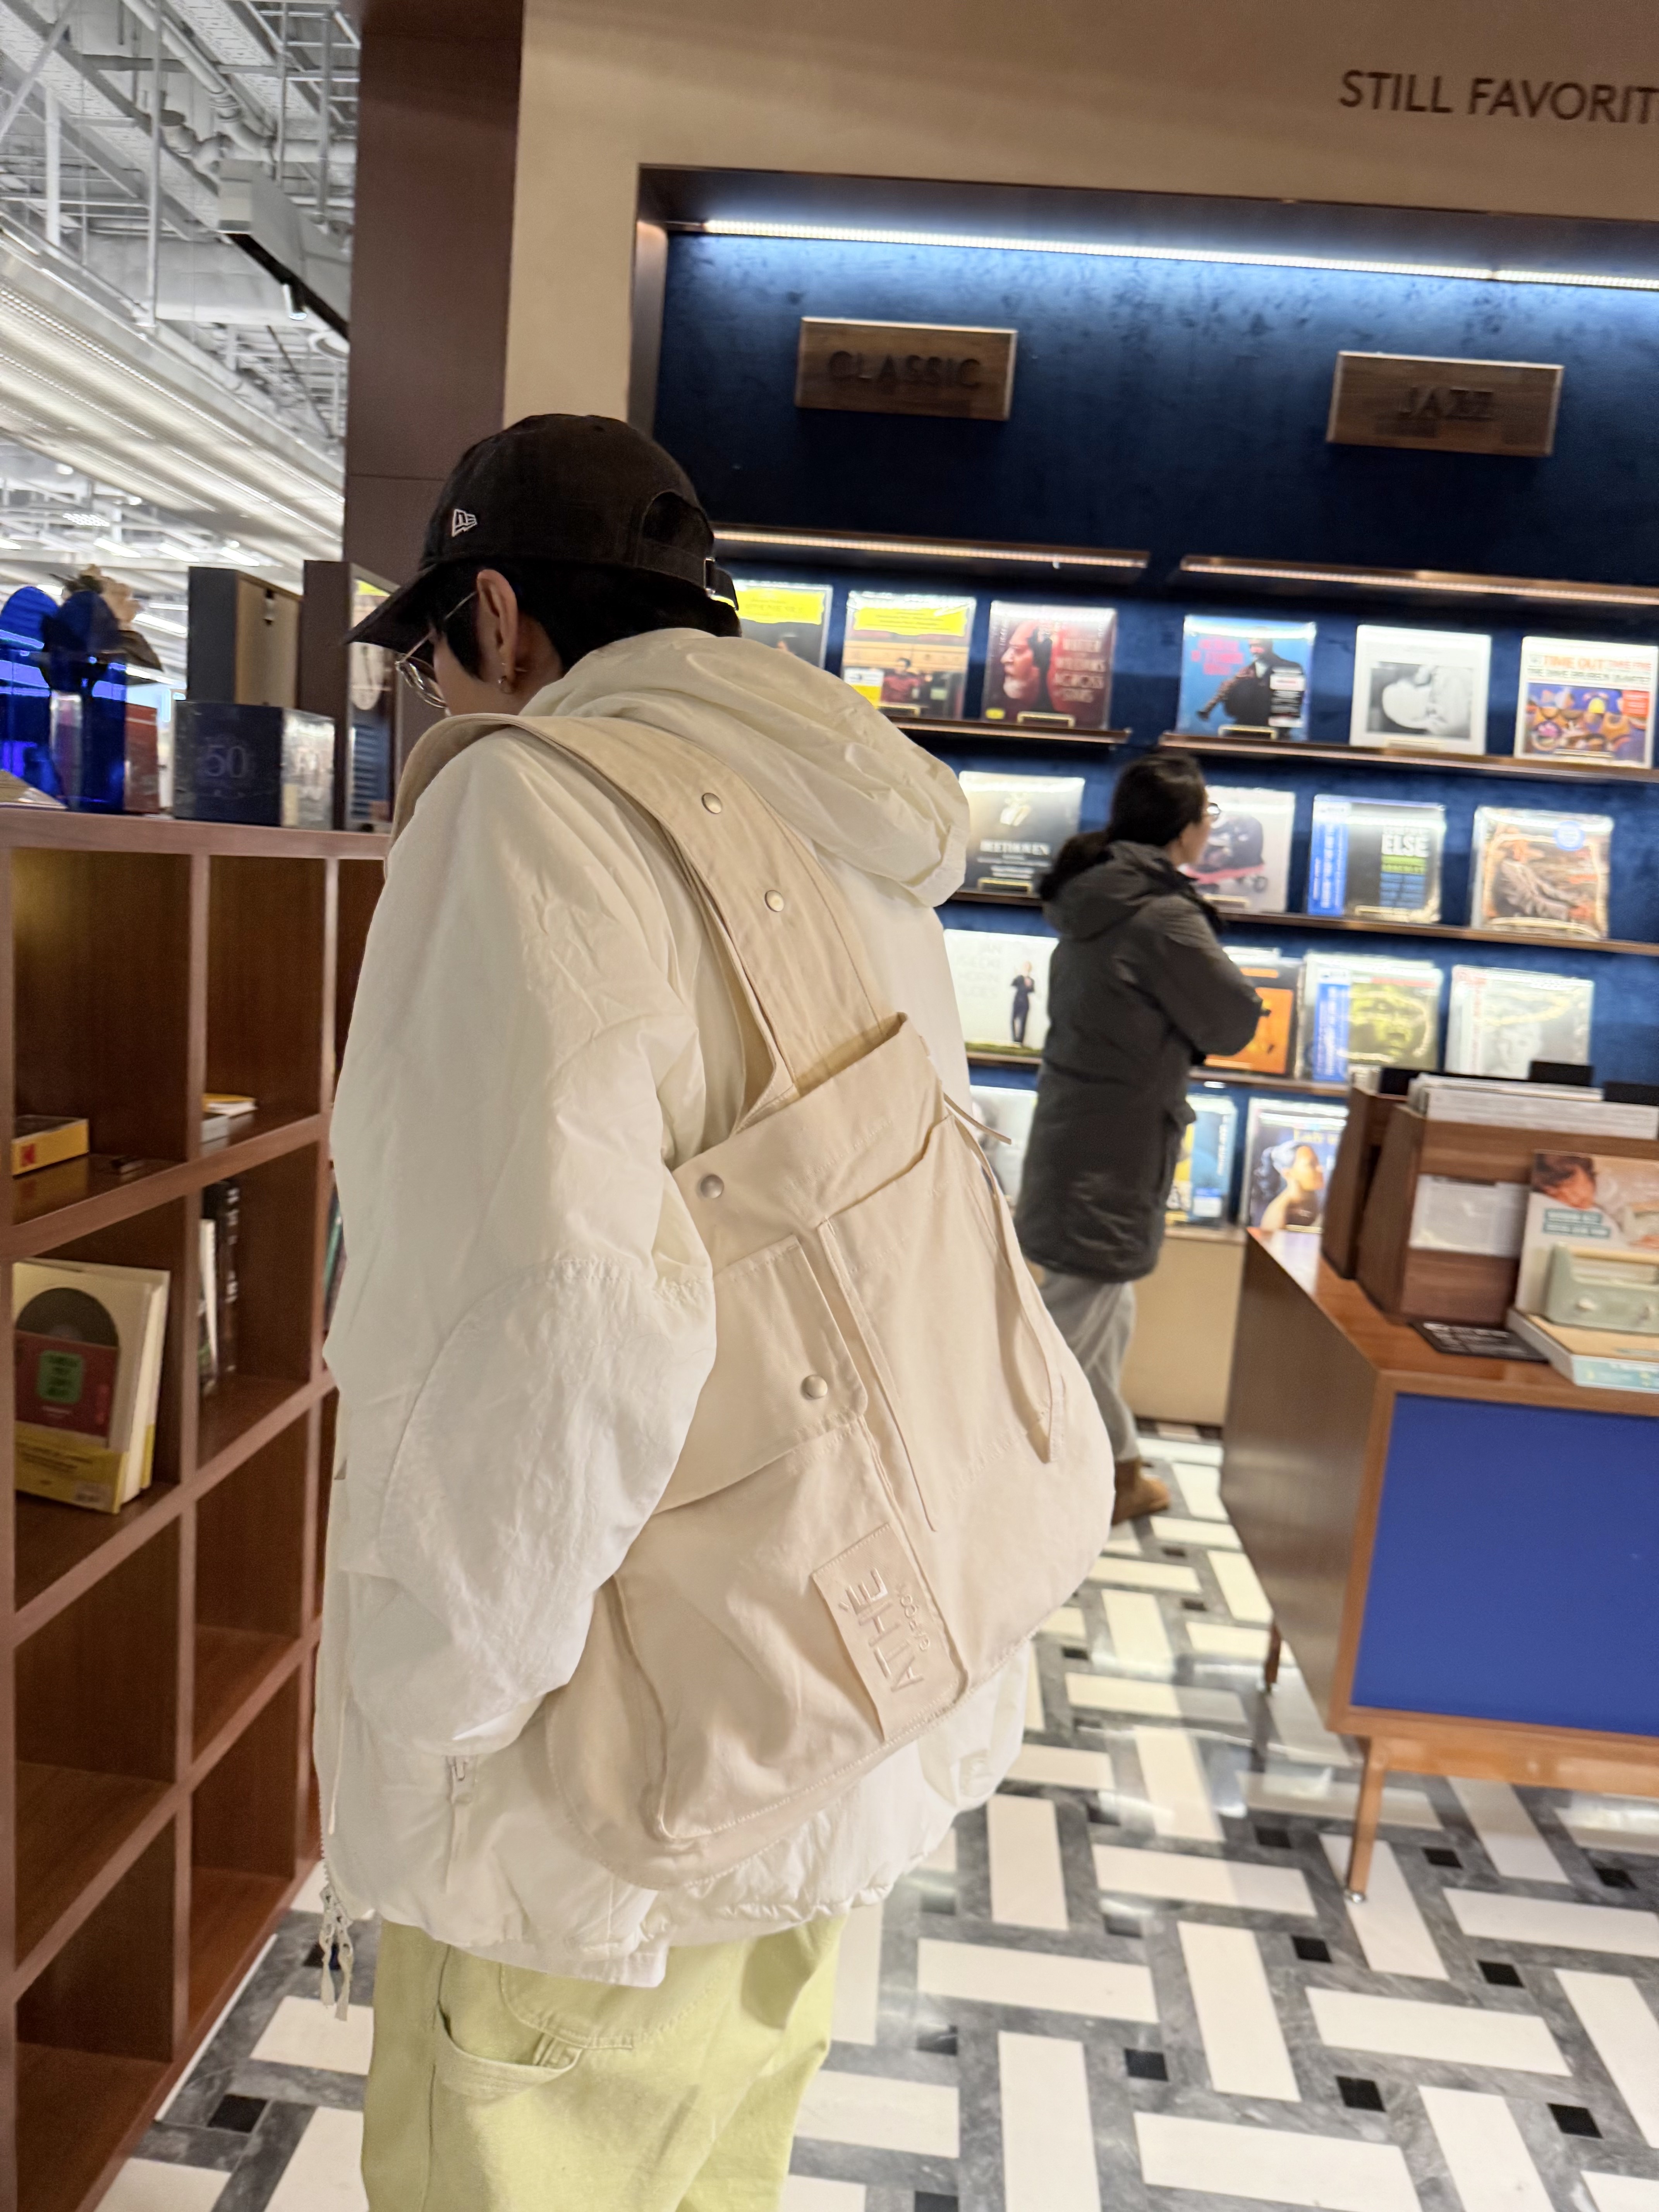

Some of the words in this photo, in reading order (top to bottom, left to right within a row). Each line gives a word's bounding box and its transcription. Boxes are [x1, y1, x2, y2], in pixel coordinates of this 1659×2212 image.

[1339, 70, 1453, 113] STILL
[1468, 77, 1659, 124] FAVORIT
[1381, 834, 1430, 858] ELSE
